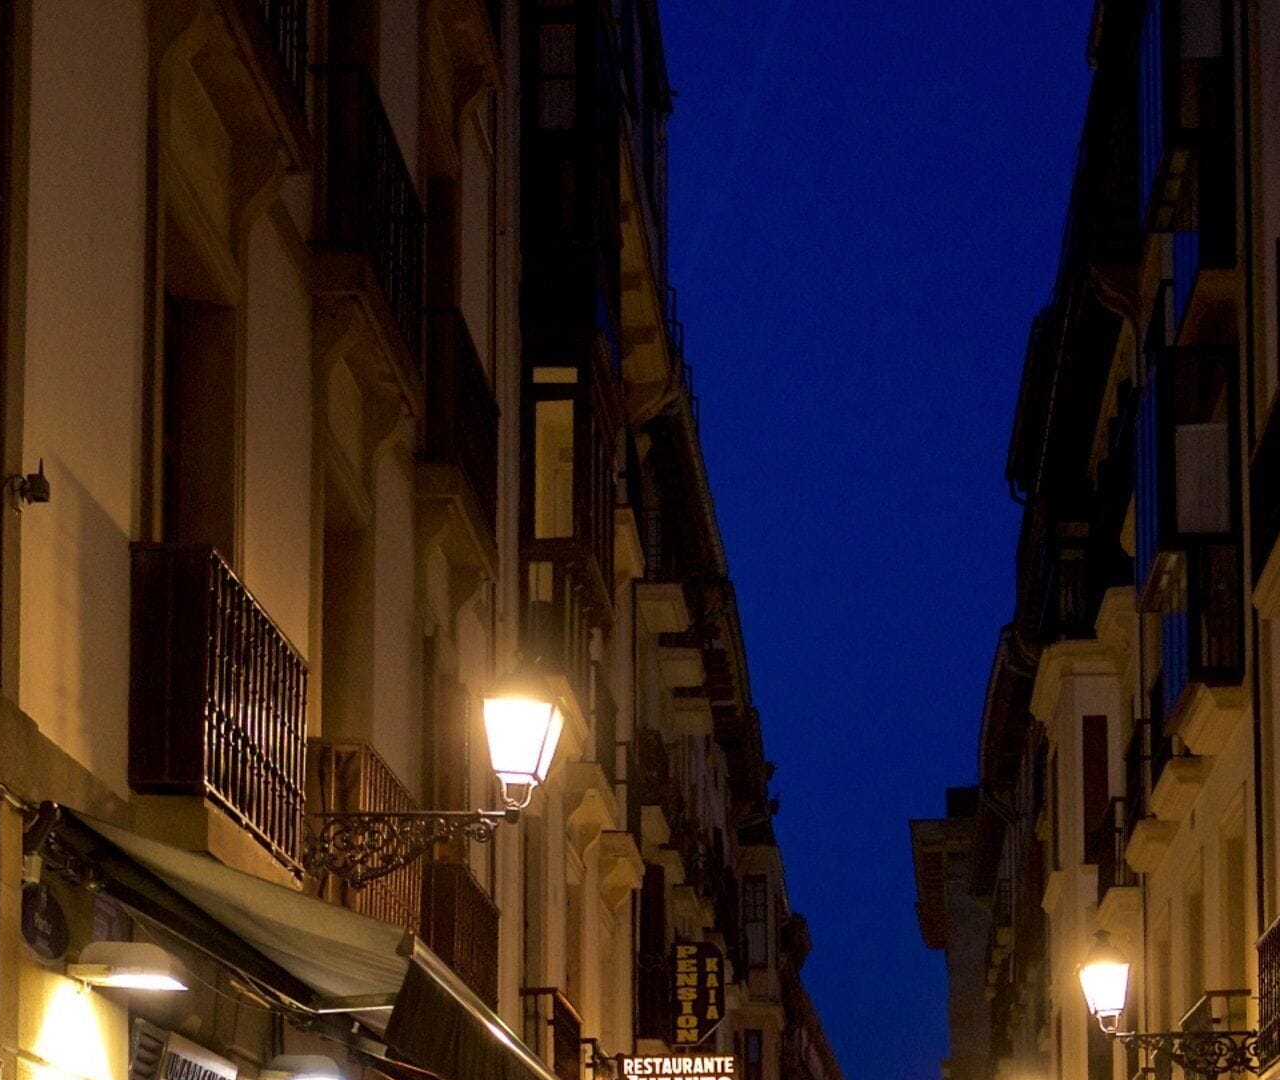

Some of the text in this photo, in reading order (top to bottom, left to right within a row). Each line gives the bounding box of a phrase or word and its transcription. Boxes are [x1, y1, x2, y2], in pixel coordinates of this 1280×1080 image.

[676, 946, 699, 1043] PENSION
[704, 957, 719, 1020] KAIA
[623, 1056, 734, 1075] RESTAURANTE
